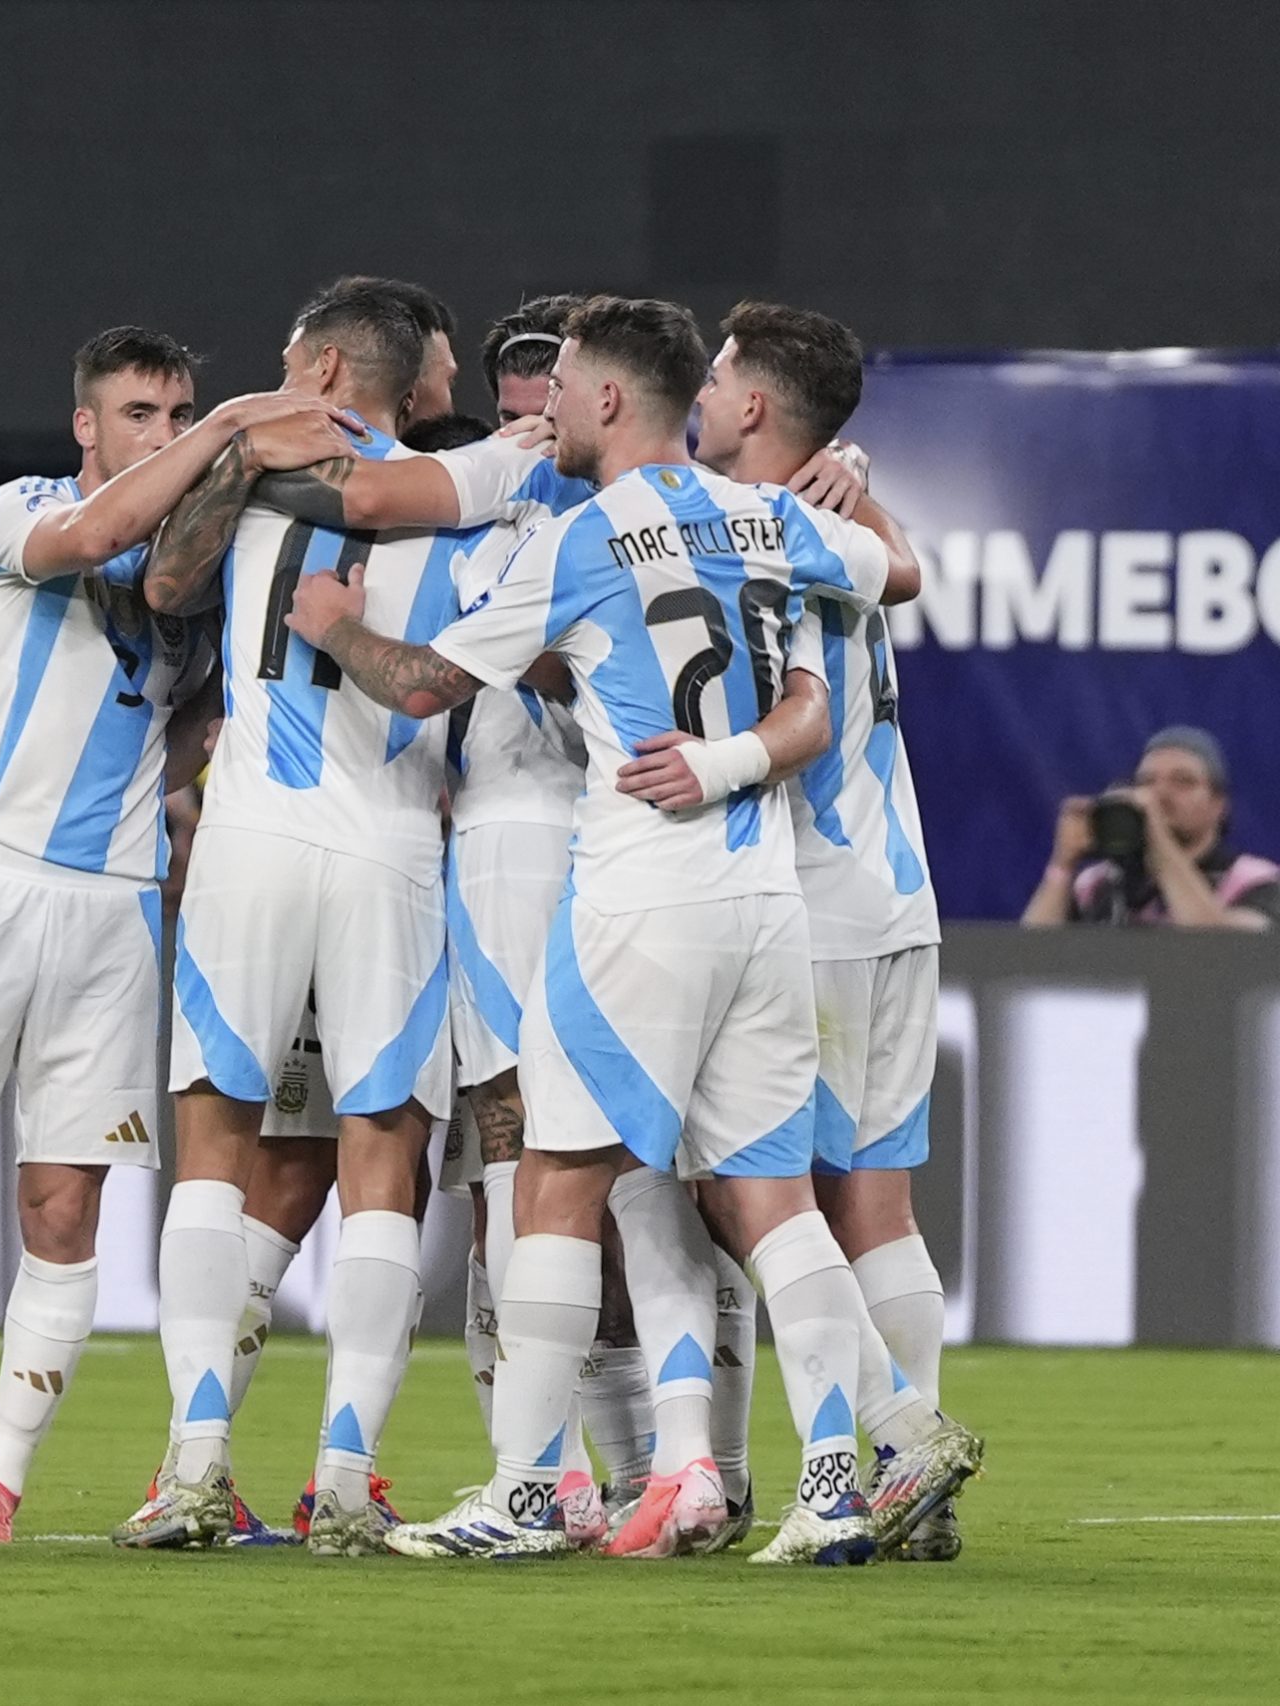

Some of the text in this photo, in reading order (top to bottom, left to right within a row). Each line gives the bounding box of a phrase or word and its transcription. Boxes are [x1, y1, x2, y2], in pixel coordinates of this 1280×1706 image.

[607, 516, 787, 570] MAC ALLISTER
[644, 577, 794, 739] 20
